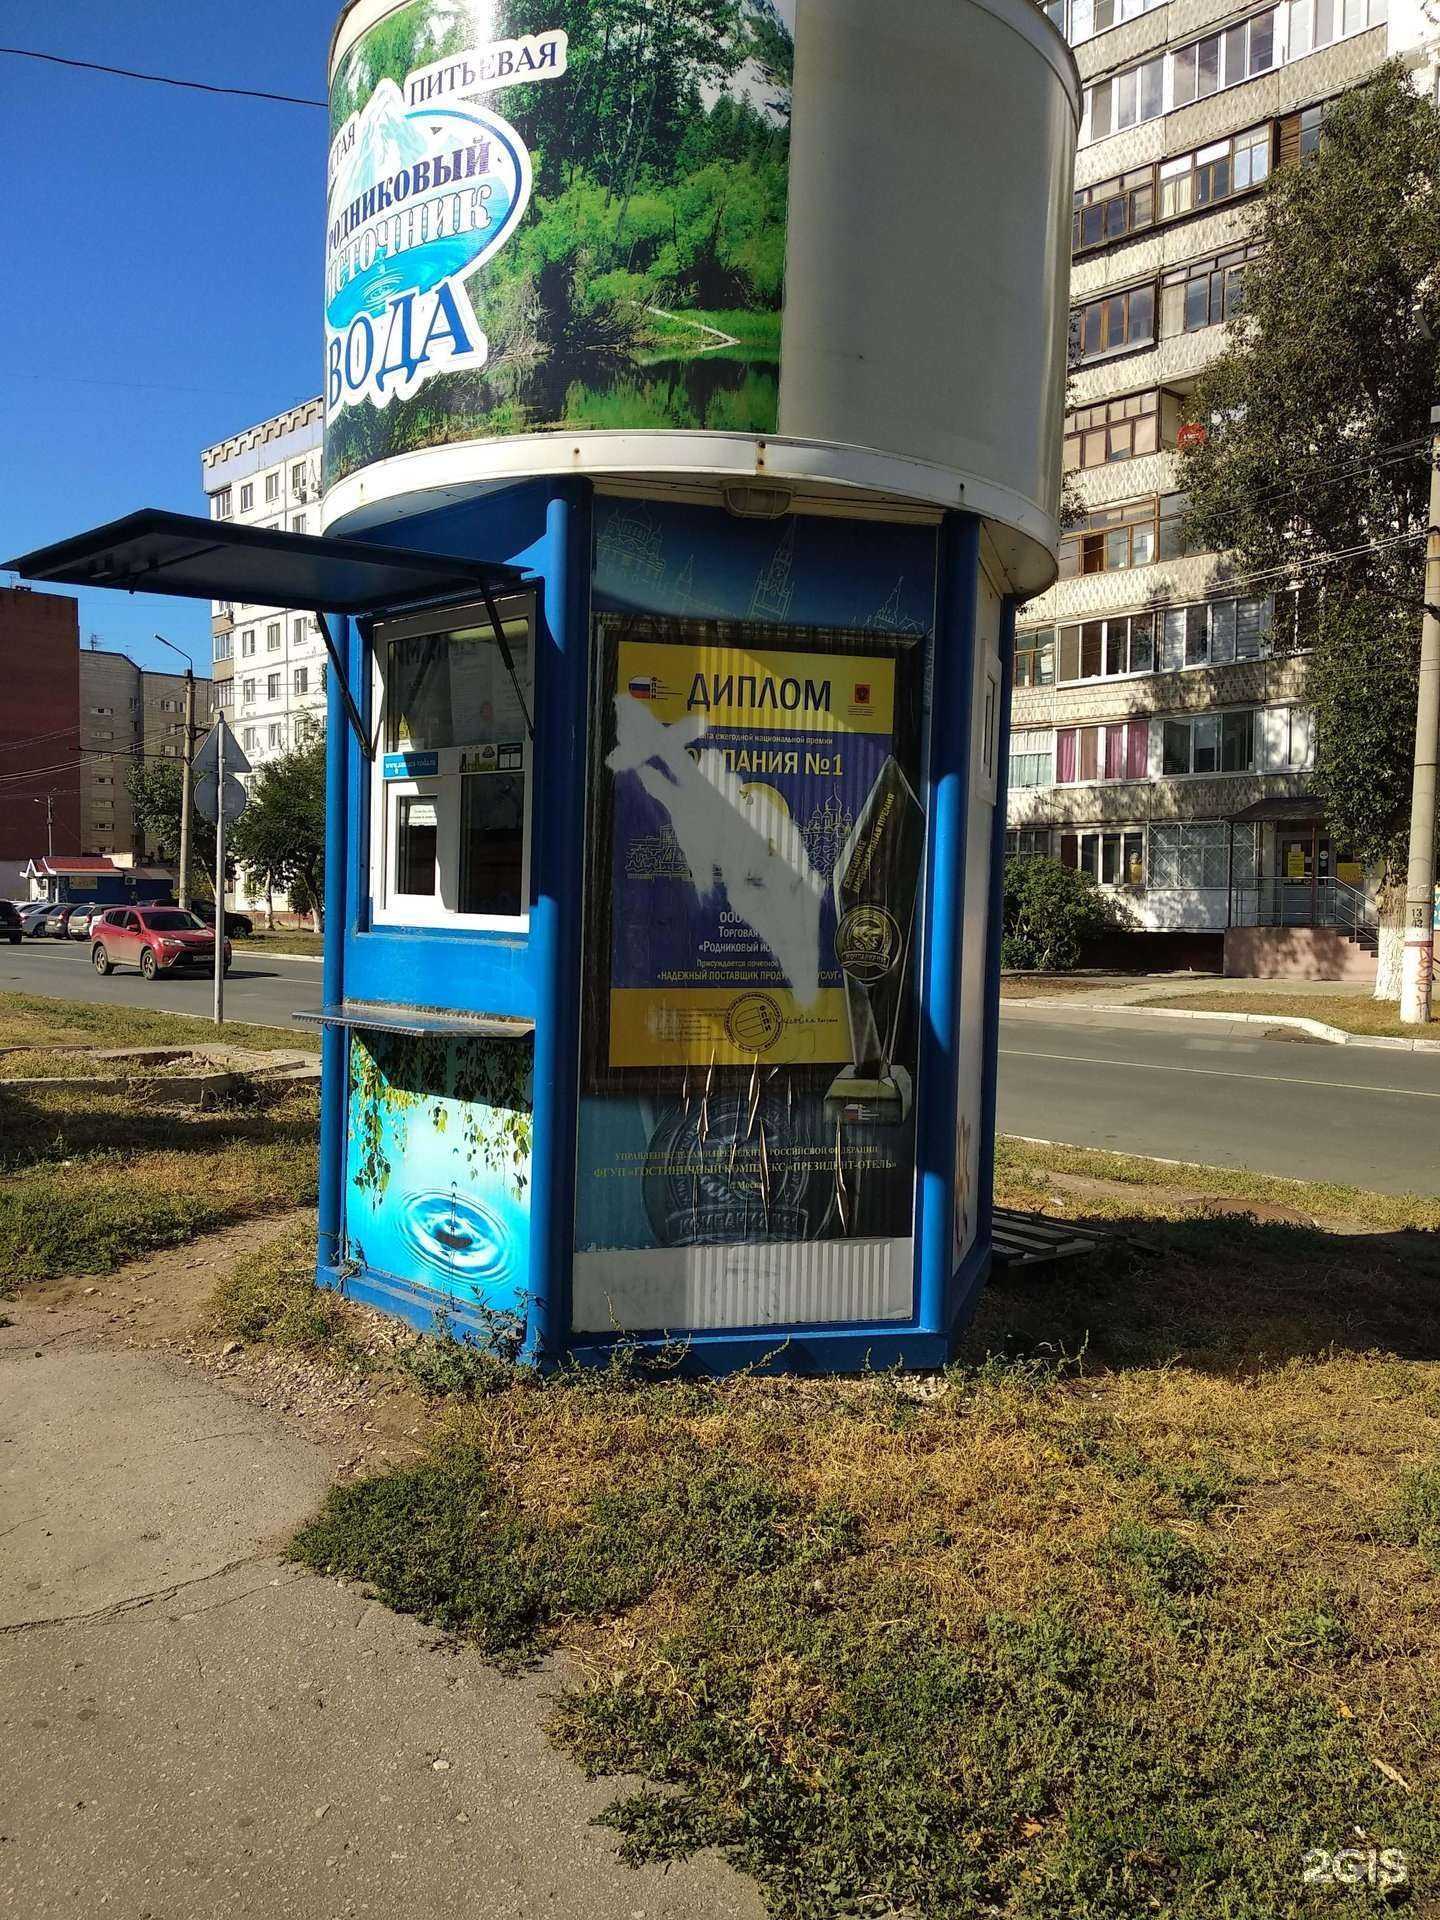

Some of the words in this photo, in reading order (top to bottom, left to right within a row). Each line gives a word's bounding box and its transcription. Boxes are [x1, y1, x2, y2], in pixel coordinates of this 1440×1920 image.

[410, 42, 558, 106] ПИТЬЕВАЯ
[328, 135, 491, 260] РОДНИКОВЫЙ
[328, 282, 473, 410] ВОДА
[686, 673, 832, 713] ДИПЛОМ
[804, 752, 843, 776] №1
